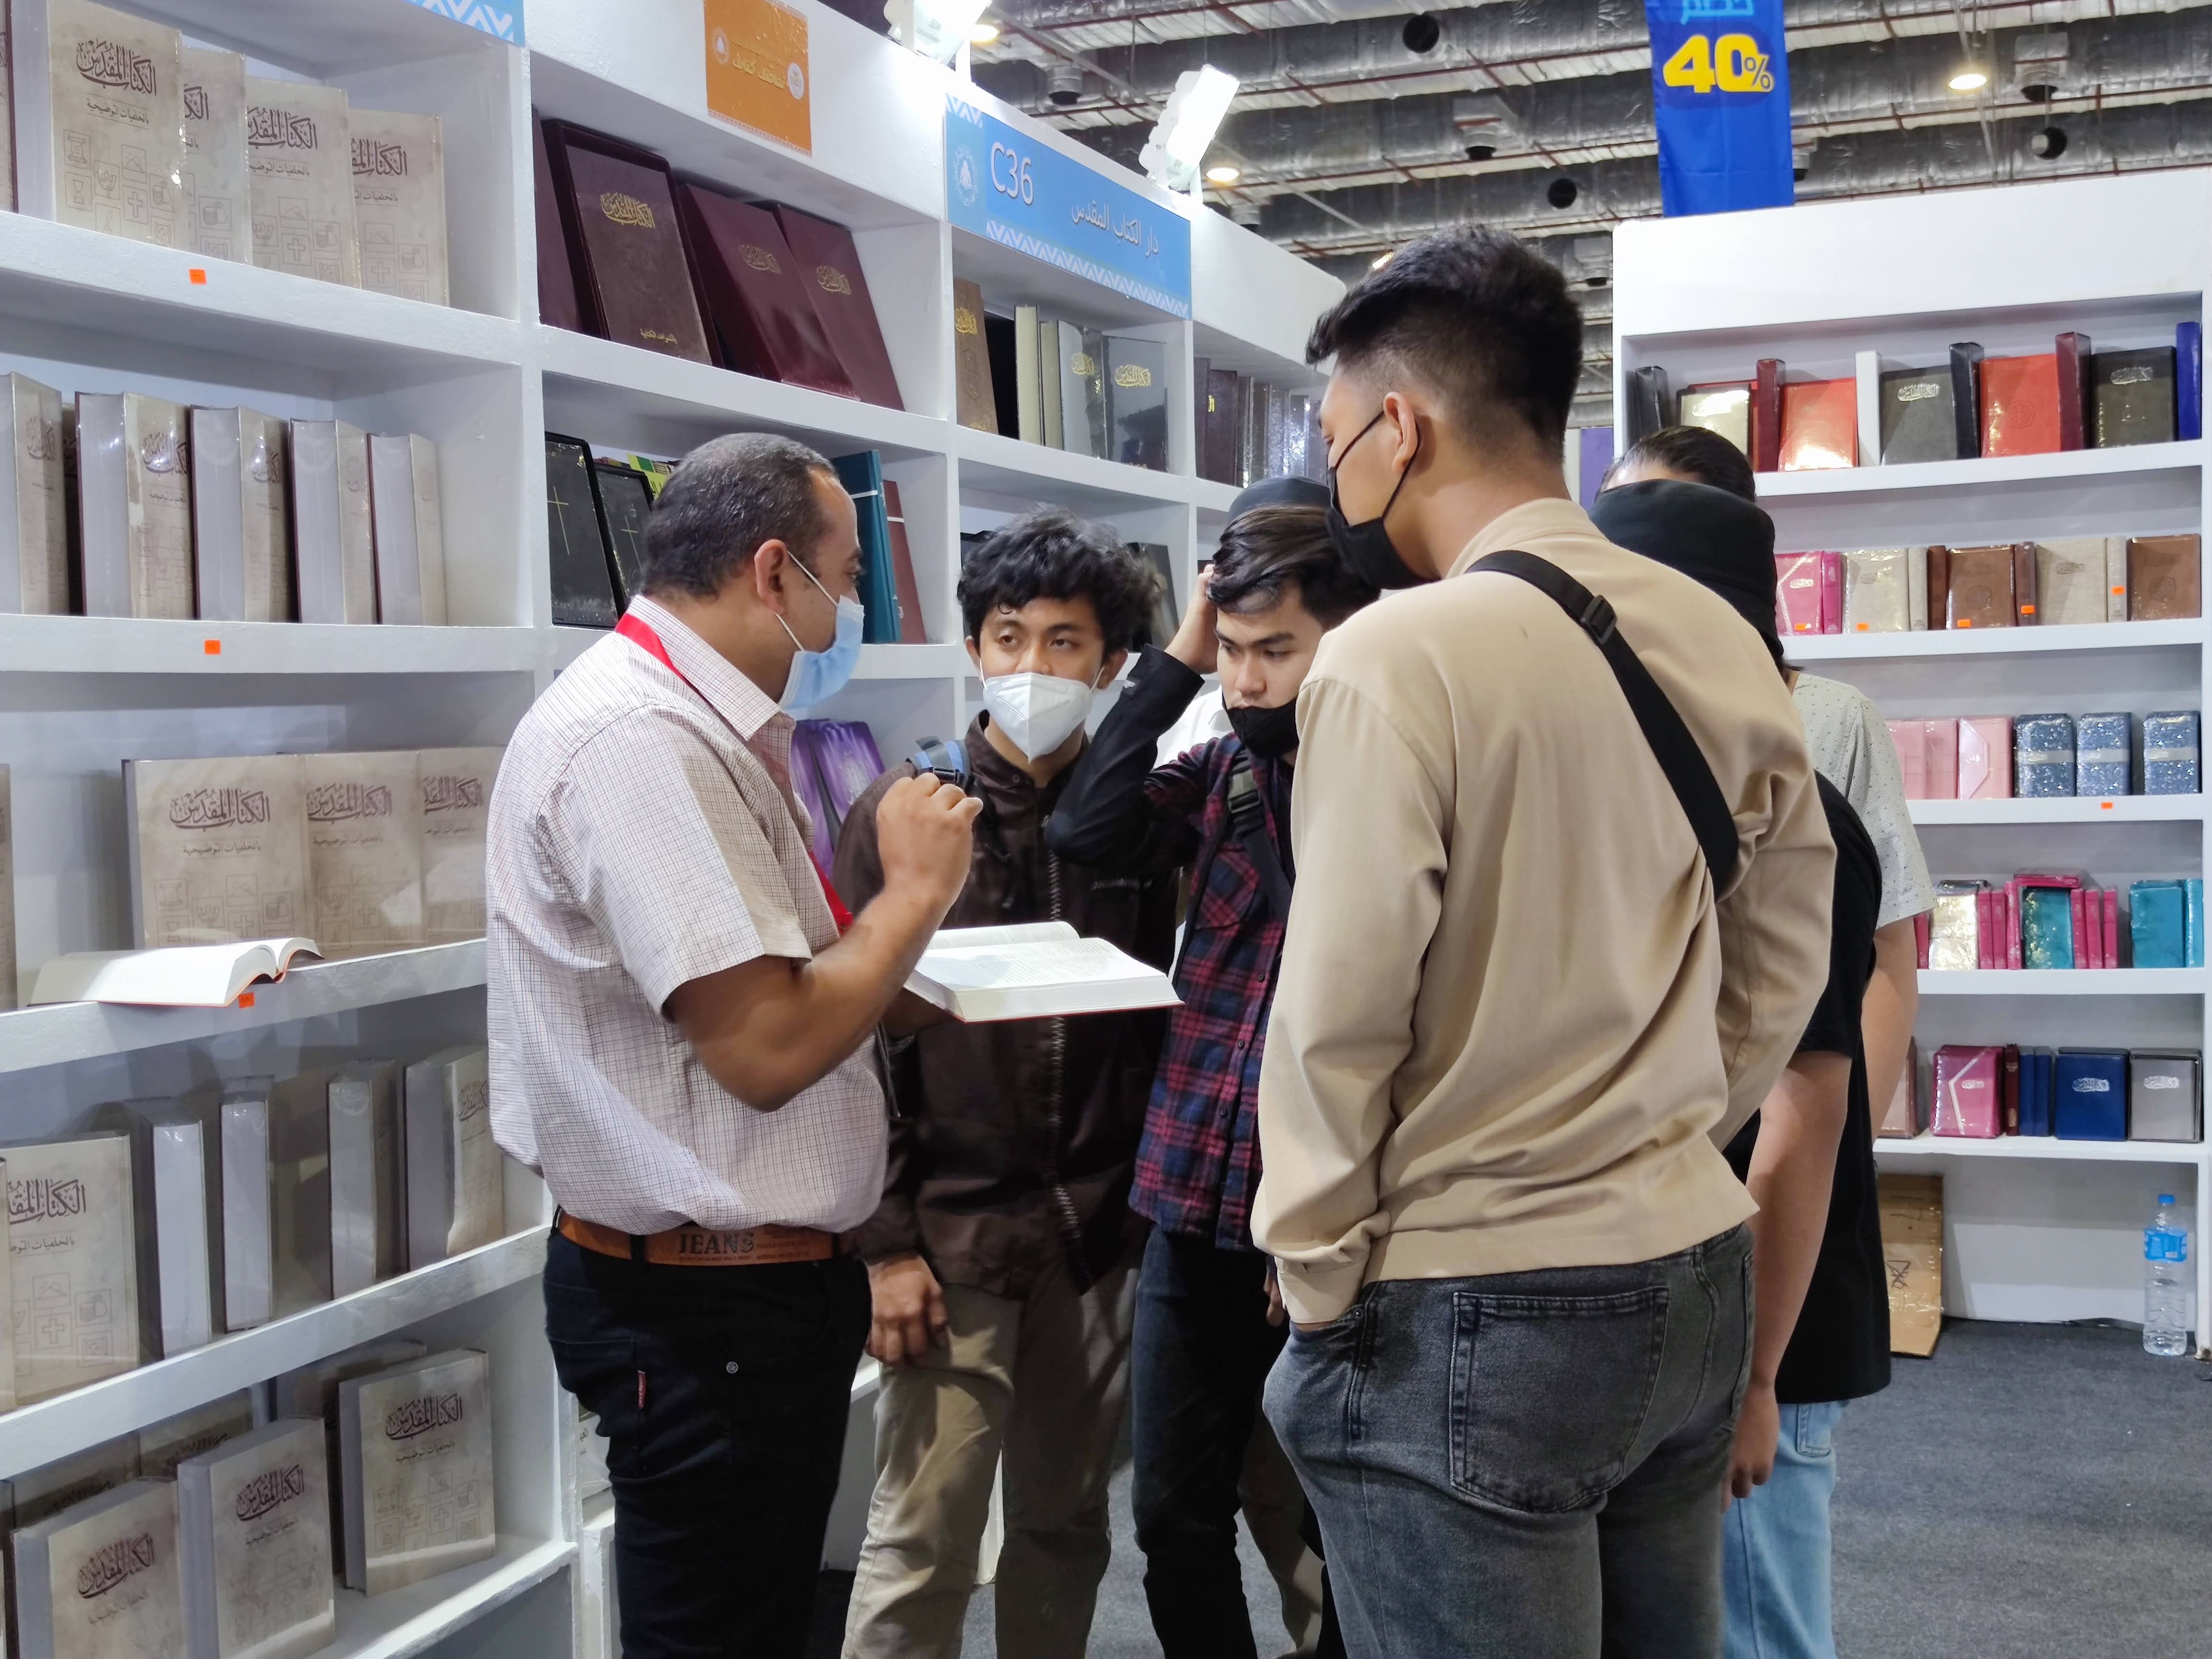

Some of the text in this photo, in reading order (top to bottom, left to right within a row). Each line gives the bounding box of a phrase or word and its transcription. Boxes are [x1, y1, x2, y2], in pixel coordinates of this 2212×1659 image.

[1663, 33, 1774, 93] 40%
[991, 142, 1034, 205] C36
[1072, 200, 1159, 257] دار الكتاب المقدس
[678, 1232, 754, 1253] JEANS
